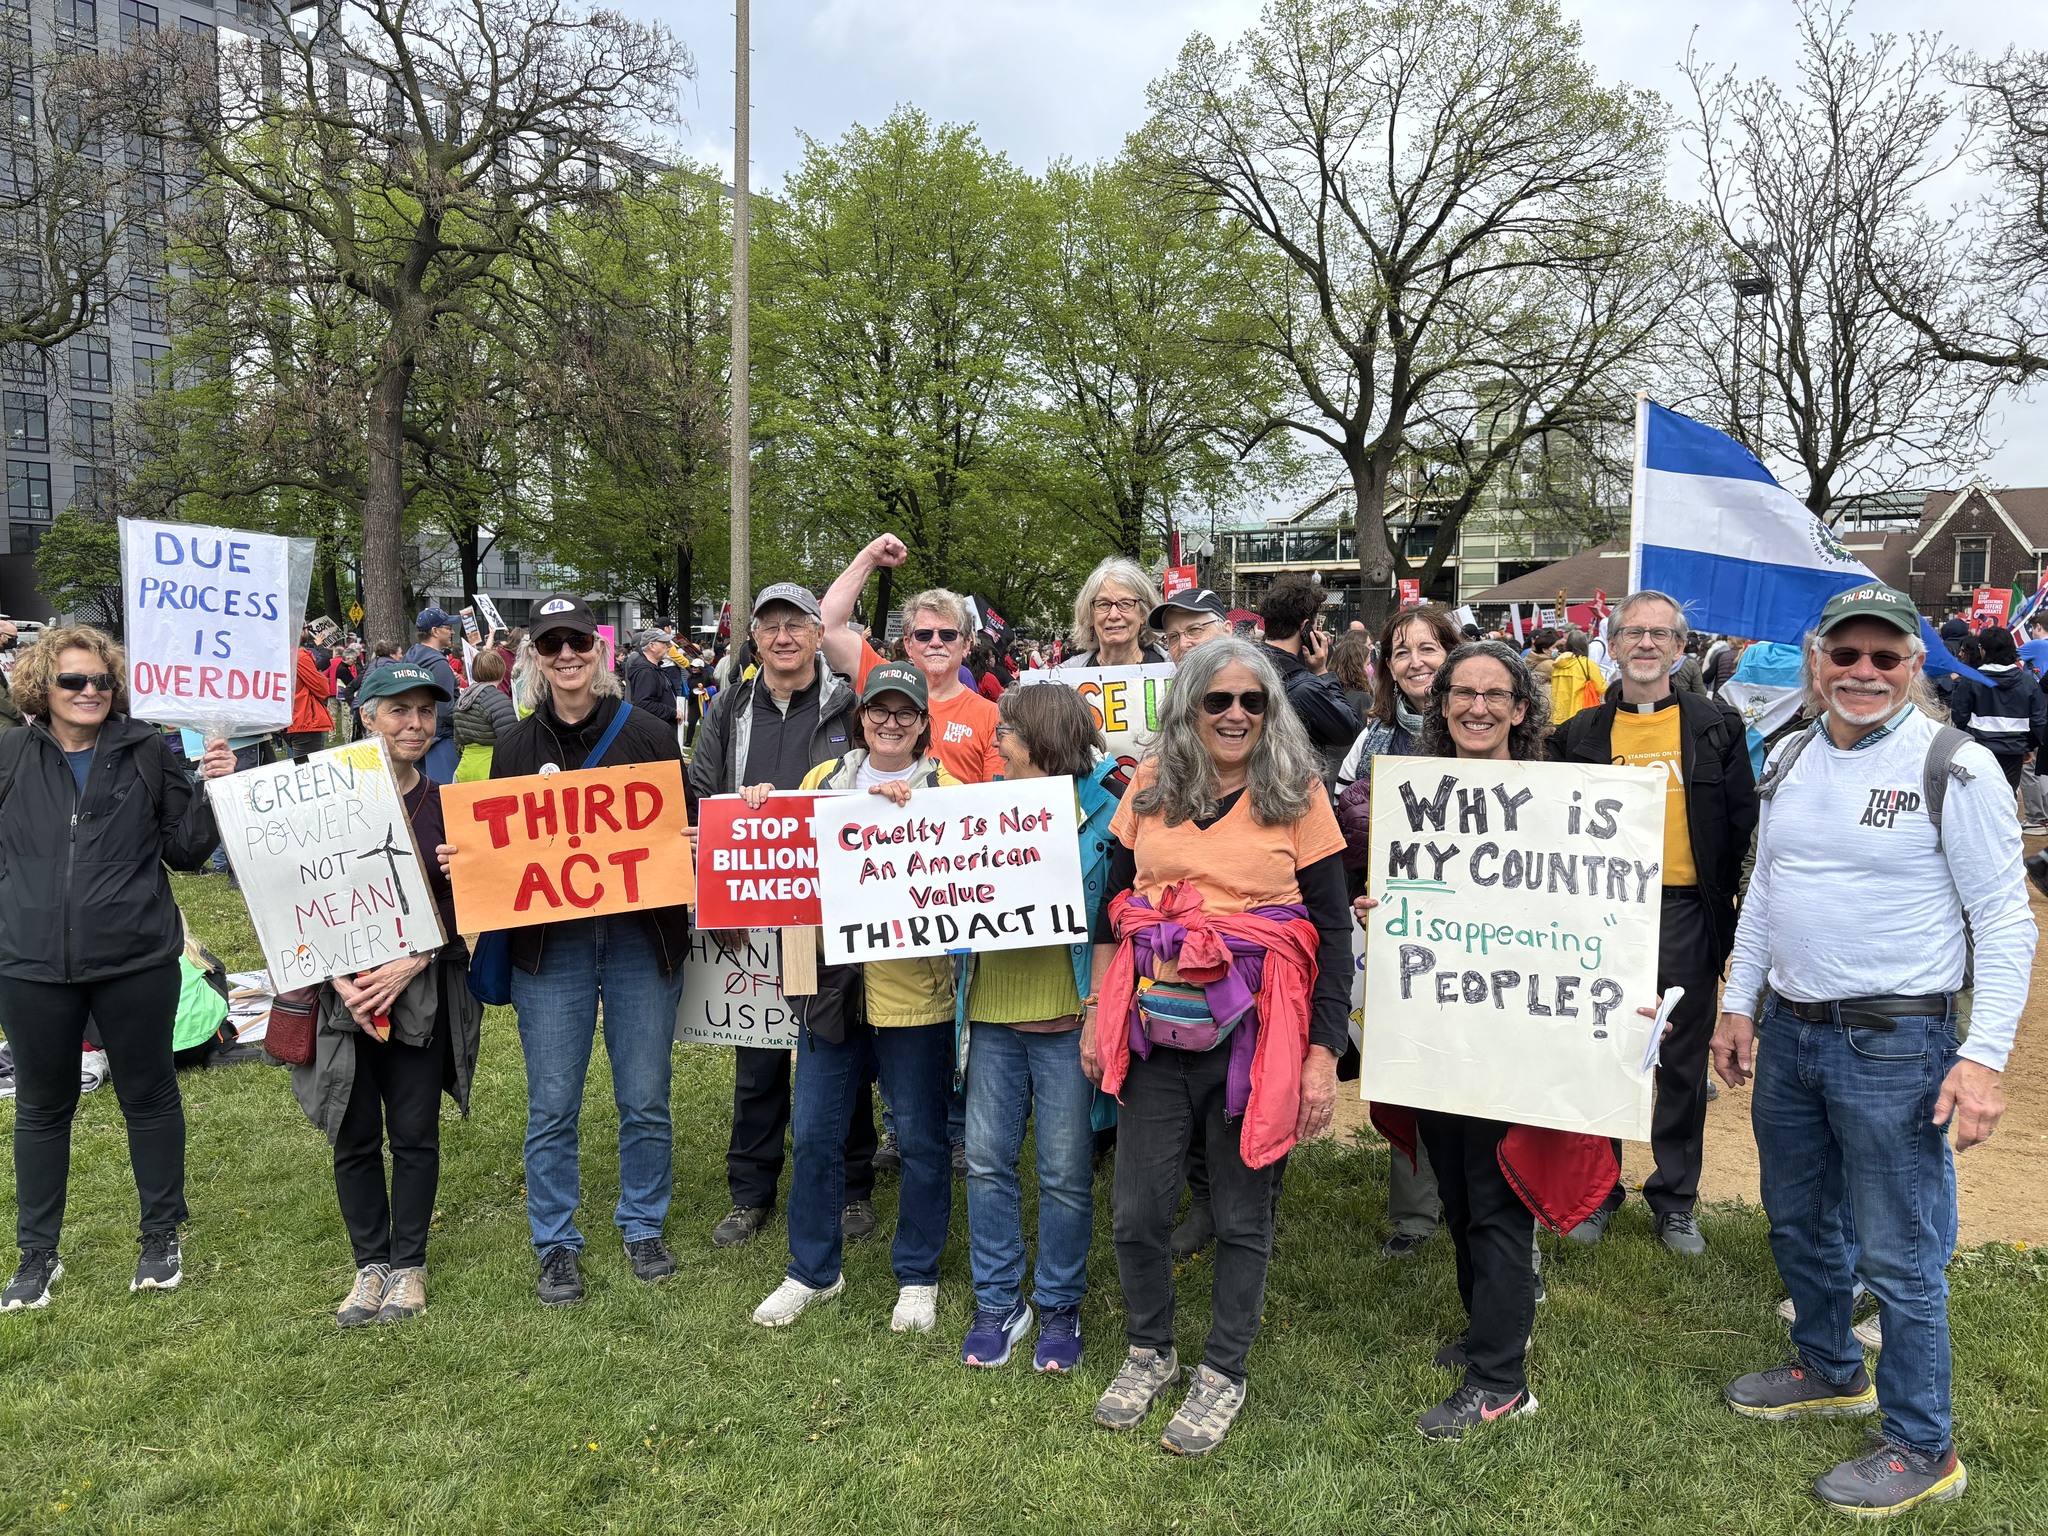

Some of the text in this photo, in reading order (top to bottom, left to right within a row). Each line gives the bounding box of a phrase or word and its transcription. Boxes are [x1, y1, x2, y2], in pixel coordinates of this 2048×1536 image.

[155, 532, 251, 574] DUE
[139, 577, 278, 621] PROCESS
[548, 601, 564, 611] 44
[1875, 591, 1897, 604] ACT
[194, 630, 232, 659] IS
[134, 661, 287, 702] OVERDUE
[902, 671, 917, 685] ACT
[1077, 678, 1173, 732] SE U
[943, 730, 963, 743] ACT
[1627, 752, 1660, 760] STANDING
[252, 756, 355, 813] GREEN
[1398, 774, 1534, 835] WHY
[1868, 789, 1920, 811] TH!RD
[245, 799, 371, 860] POWER
[473, 781, 664, 849] TH!RD
[731, 817, 799, 841] STOP
[838, 806, 1054, 851] Cruelty Is Not
[1859, 807, 1899, 828] ACT
[300, 849, 357, 884] NOT
[713, 847, 819, 871] BILLION
[859, 845, 1041, 885] An American
[1388, 841, 1659, 903] MY COUNTRY
[513, 848, 650, 911] ACT
[726, 877, 821, 901] TAKEOV
[909, 882, 996, 909] Value
[295, 877, 396, 934] MEAN
[839, 904, 1088, 953] TH!RD ACT IL
[1380, 893, 1617, 970] "disappearing"
[690, 934, 769, 969] HAN
[1398, 944, 1624, 1040] PEOPLE?
[683, 1027, 709, 1037] OUR
[713, 1031, 753, 1045] MAIL!!
[761, 1037, 783, 1045] OUR
